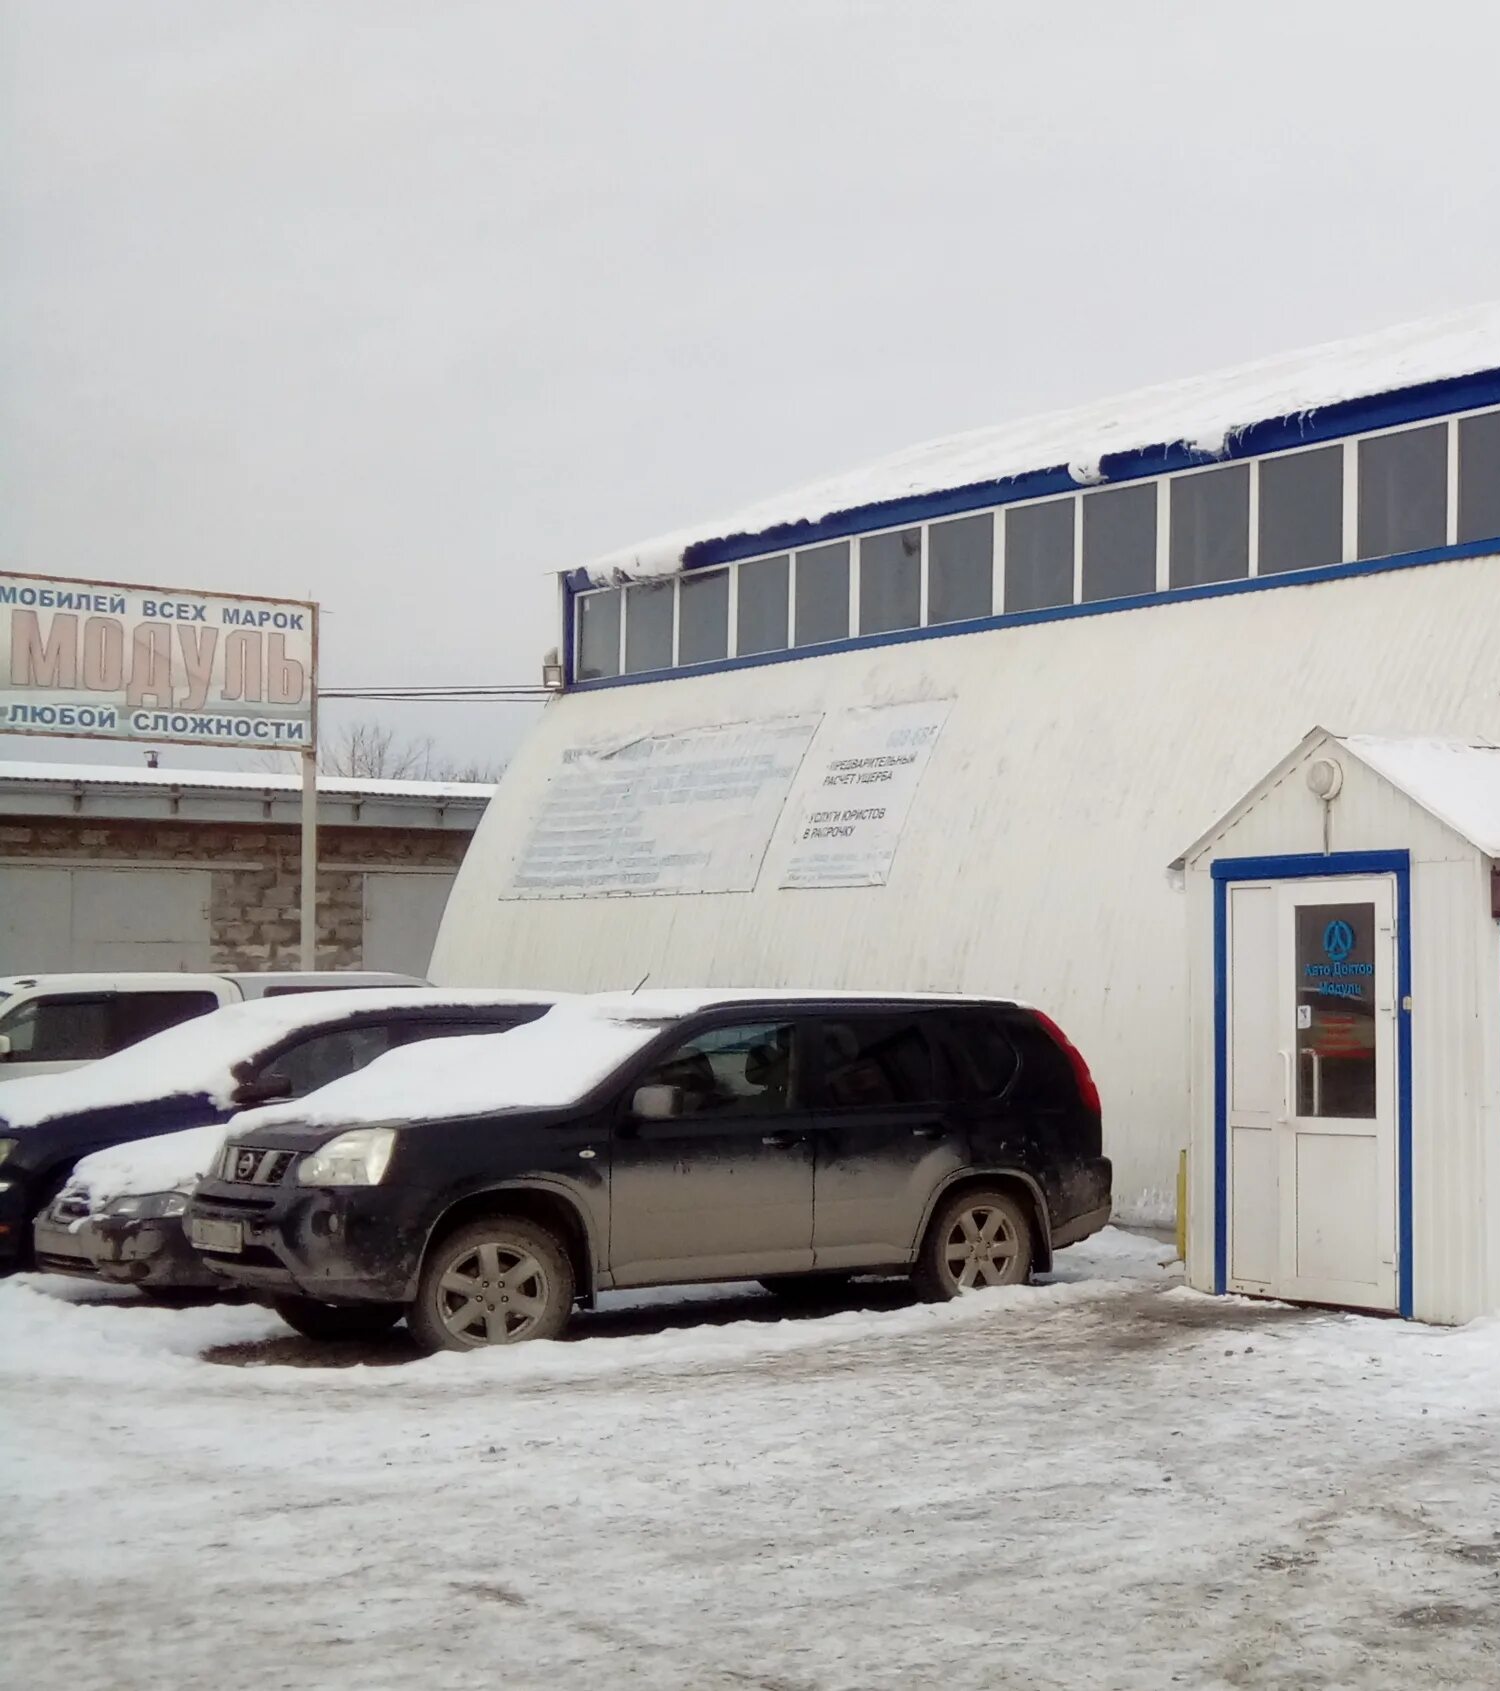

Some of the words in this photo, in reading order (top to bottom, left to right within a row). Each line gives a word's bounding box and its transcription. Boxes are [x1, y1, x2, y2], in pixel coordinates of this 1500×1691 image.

[142, 600, 206, 622] ВСЕХ
[222, 607, 304, 631] МАРОК
[10, 609, 304, 711] МОДУЛЬ
[9, 704, 116, 729] ЛЮБОЙ
[133, 713, 304, 739] СЛОЖНОСТИ
[822, 773, 855, 786] РАСЧЕТ
[856, 771, 893, 784] УЩЕРБА
[841, 808, 886, 822] ЮРИСТОВ
[803, 828, 810, 839] В
